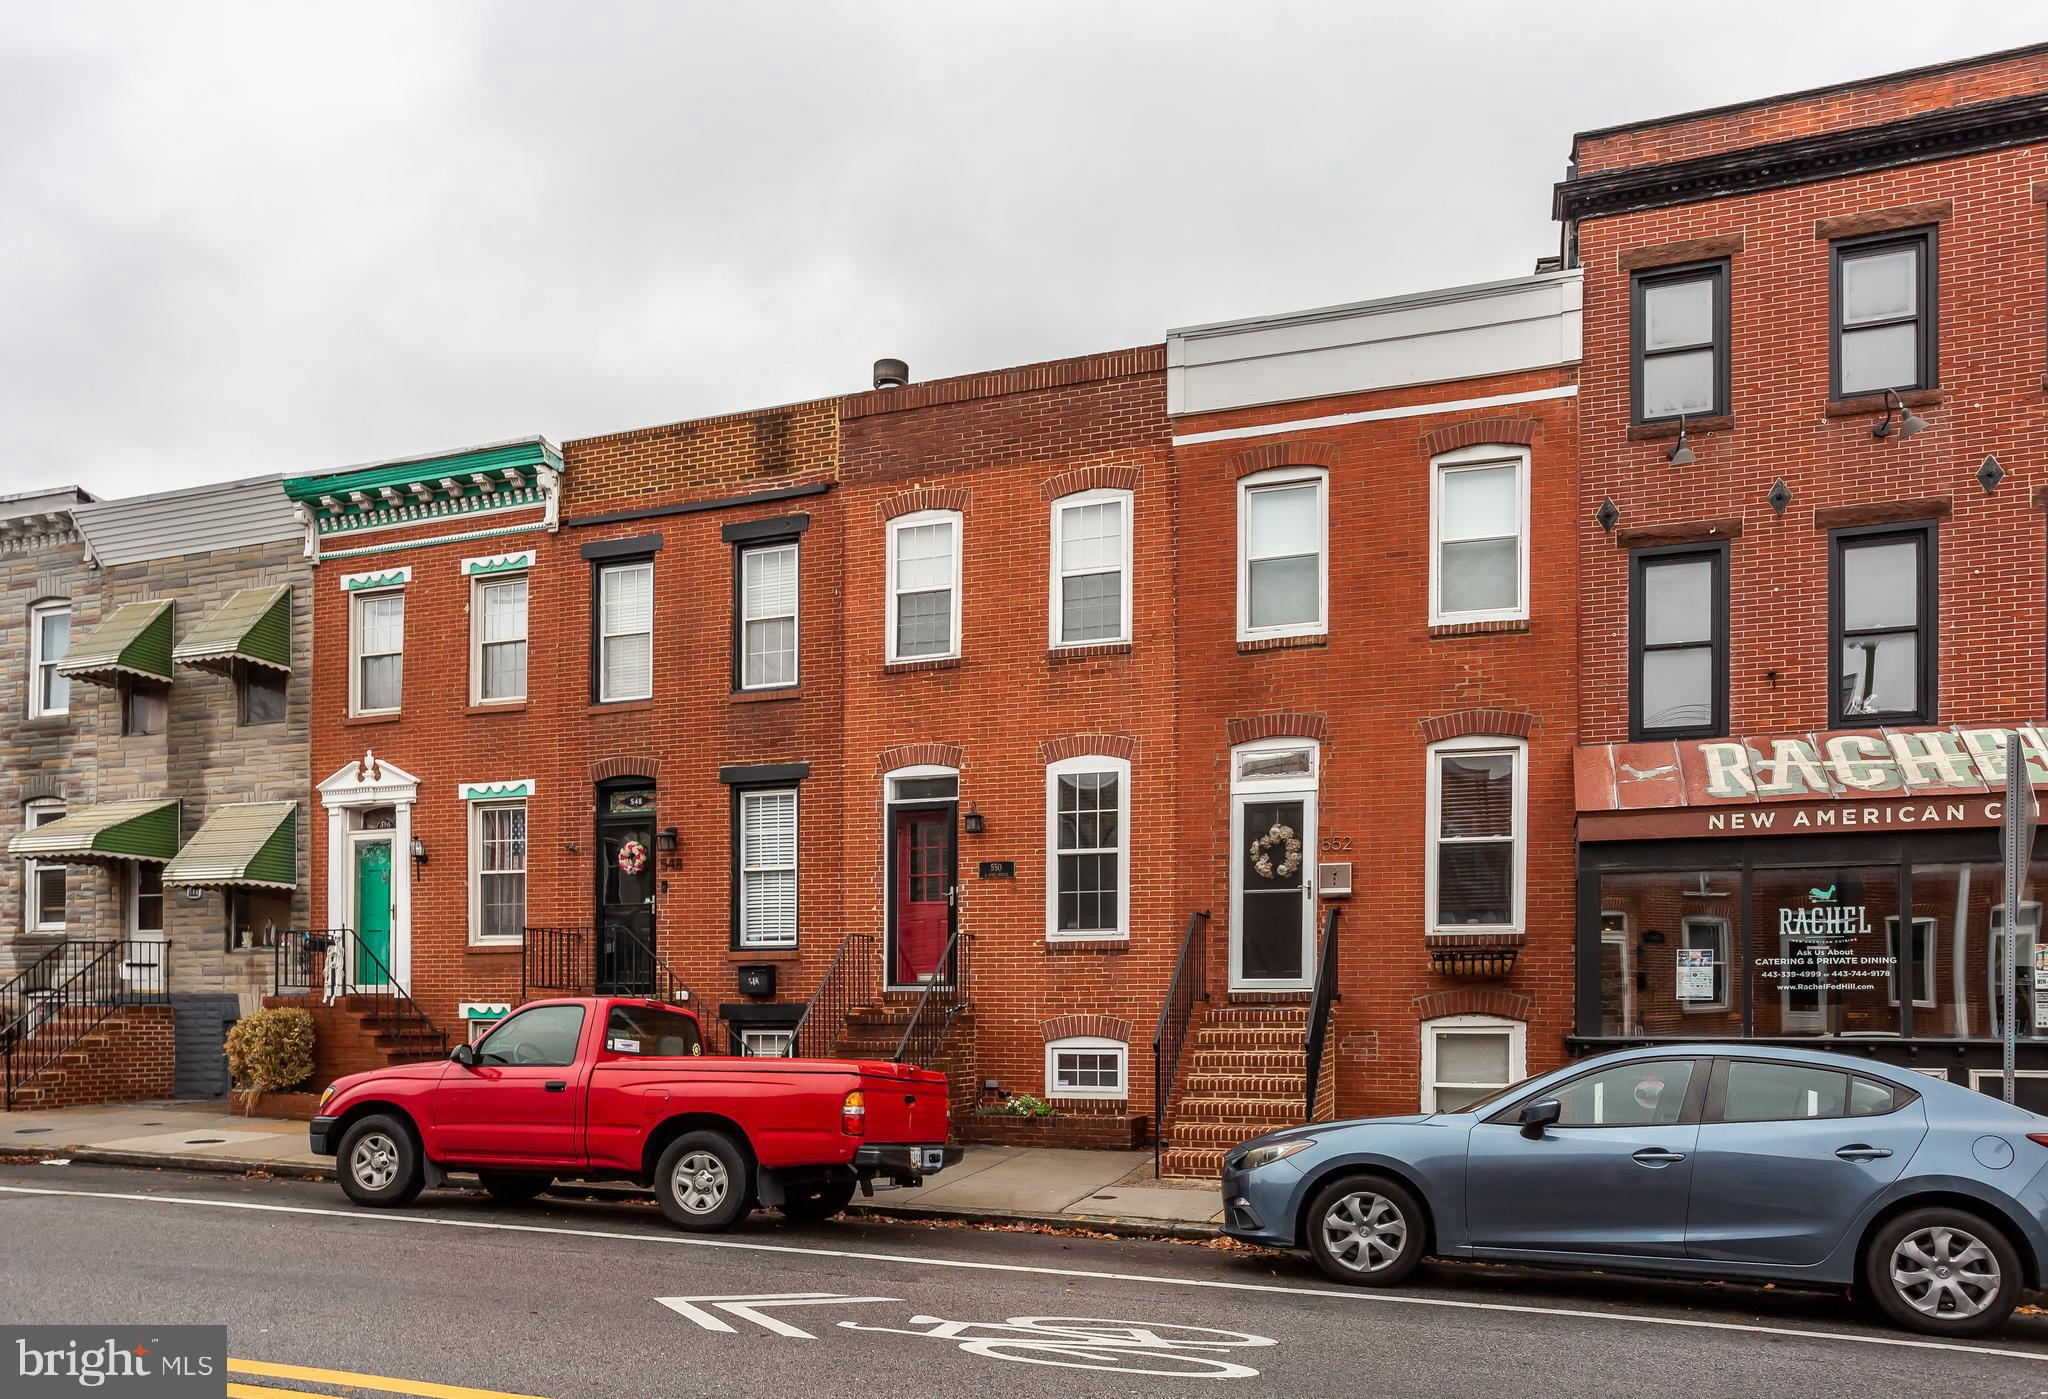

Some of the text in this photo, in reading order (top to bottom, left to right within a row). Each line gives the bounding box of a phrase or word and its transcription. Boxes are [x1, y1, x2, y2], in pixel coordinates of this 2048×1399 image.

[630, 797, 642, 805] 548
[1708, 812, 1775, 830] NEW
[1793, 804, 1965, 827] AMERICAN
[1321, 835, 1352, 851] 552
[990, 863, 1003, 872] 550
[1779, 906, 1872, 935] RACHEL
[1755, 956, 1897, 966] CATERING & PRIVATE DINING
[1761, 970, 1821, 978] 443-339-4999
[1776, 983, 1874, 991] www.RachelFedHill.com
